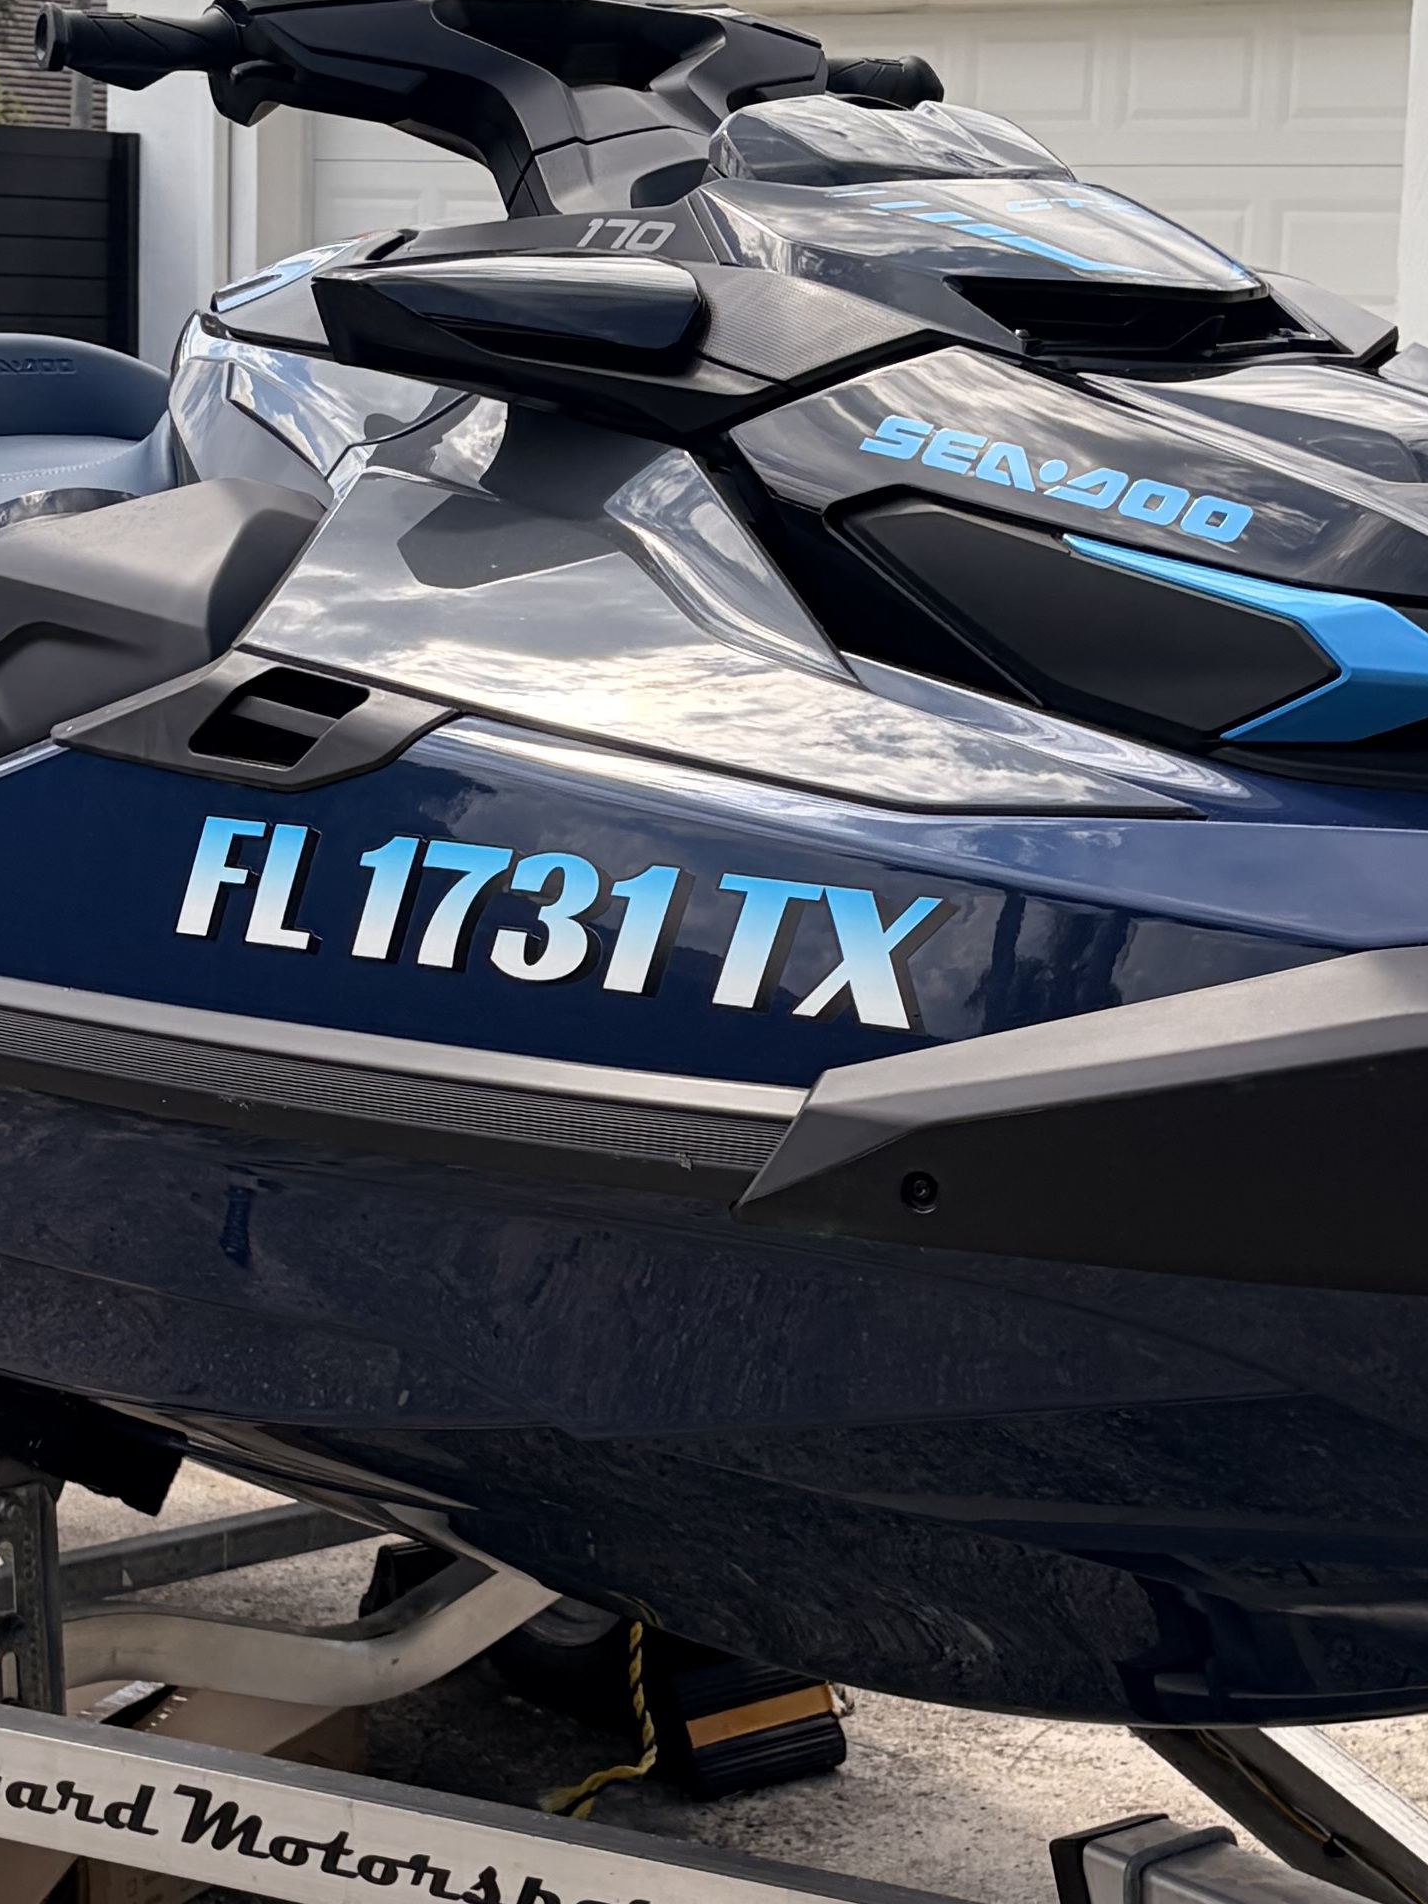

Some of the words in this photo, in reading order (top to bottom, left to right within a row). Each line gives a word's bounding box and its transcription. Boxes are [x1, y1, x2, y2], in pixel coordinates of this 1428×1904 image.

[576, 218, 676, 252] 170
[175, 815, 320, 952] FL
[351, 835, 688, 995] 1731
[711, 872, 950, 1030] TX
